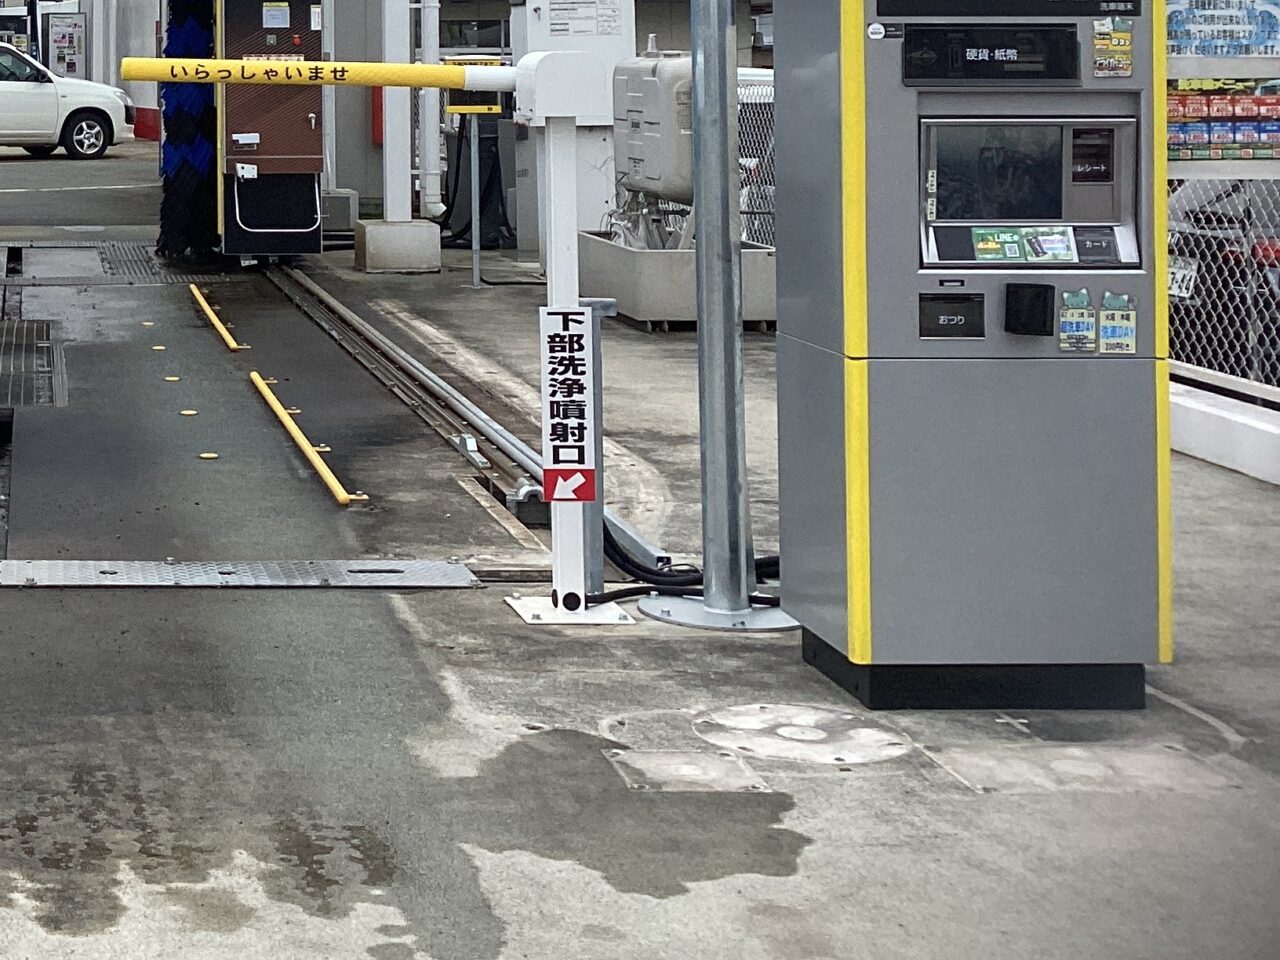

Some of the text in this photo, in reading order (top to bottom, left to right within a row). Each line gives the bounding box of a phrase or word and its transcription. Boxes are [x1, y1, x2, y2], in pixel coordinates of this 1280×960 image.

[169, 63, 350, 82] いらっしゃいませ
[1085, 240, 1109, 249] カード
[938, 315, 965, 325] おつり
[546, 311, 588, 465] 下部洗浄噴射口
